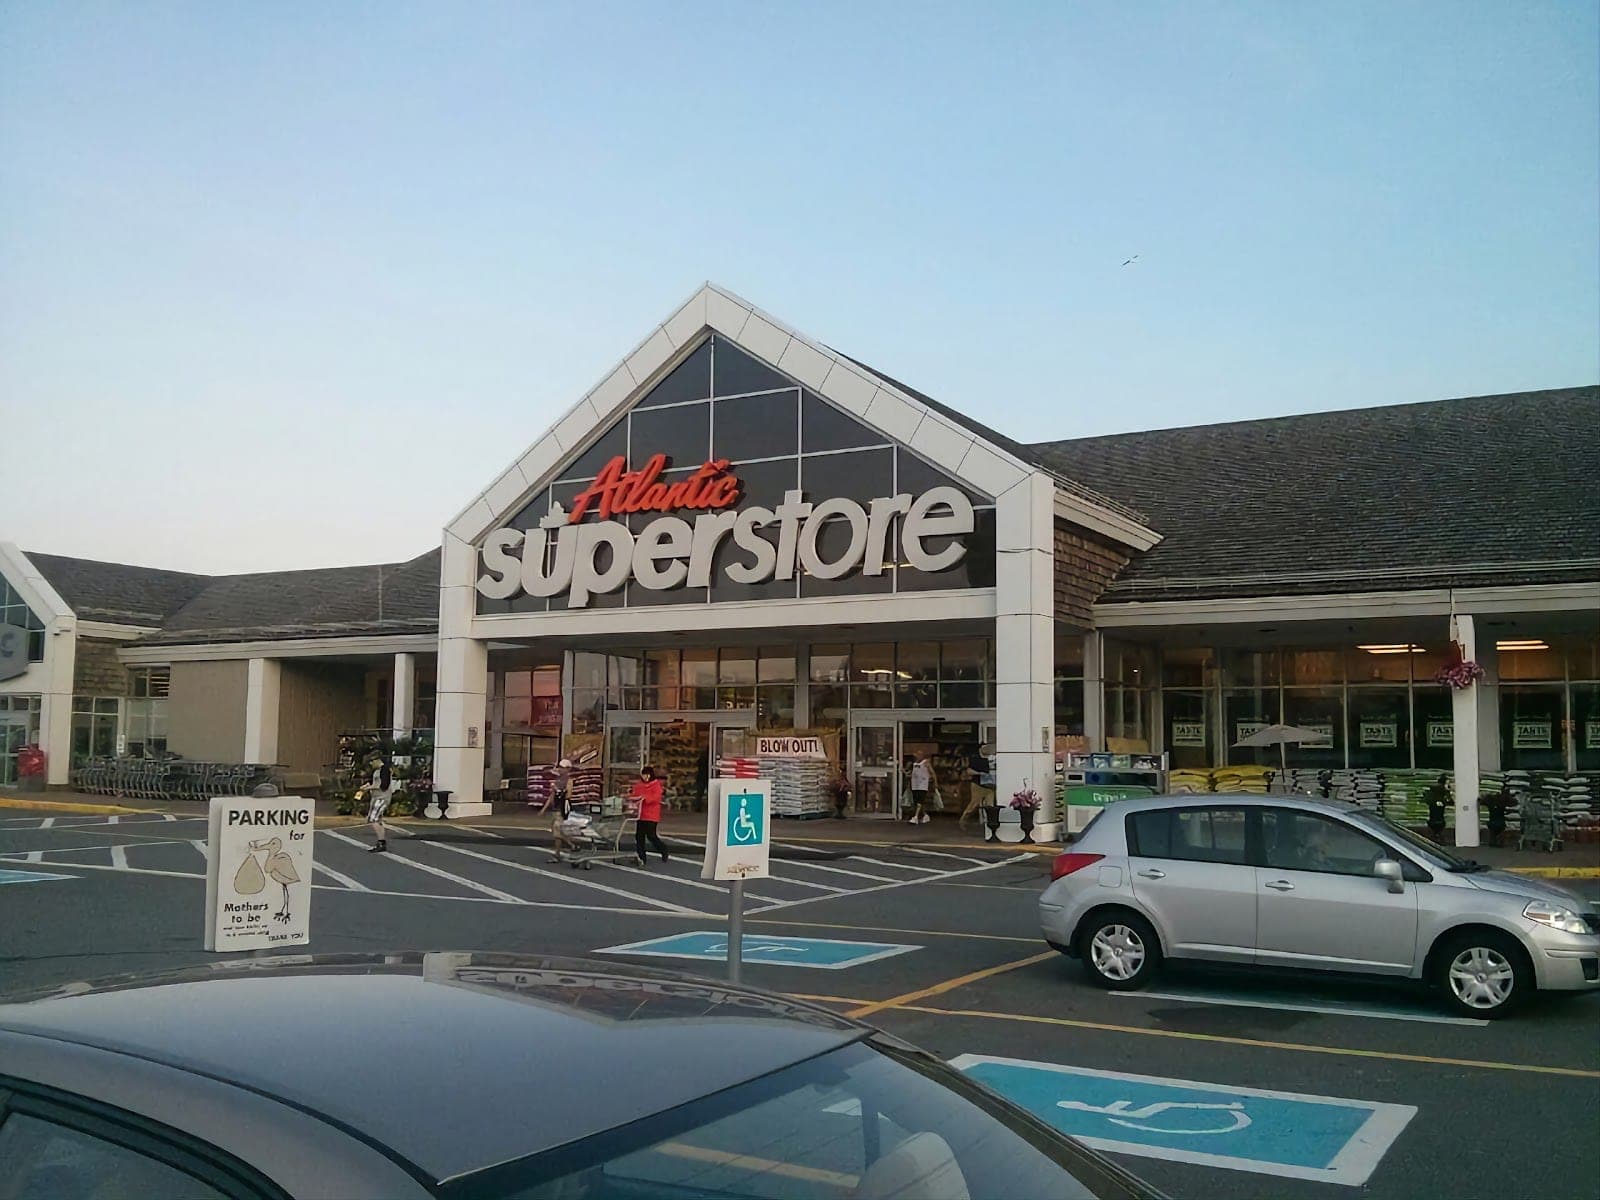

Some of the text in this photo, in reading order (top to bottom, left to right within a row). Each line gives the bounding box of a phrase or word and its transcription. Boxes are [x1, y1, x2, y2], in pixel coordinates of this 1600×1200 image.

[568, 454, 739, 523] Atlantic
[477, 486, 974, 608] superstore
[760, 739, 819, 753] BLOW OUT!
[228, 809, 309, 826] PARKING
[289, 830, 305, 841] for
[224, 902, 269, 912] Mothers
[231, 912, 261, 923] to be
